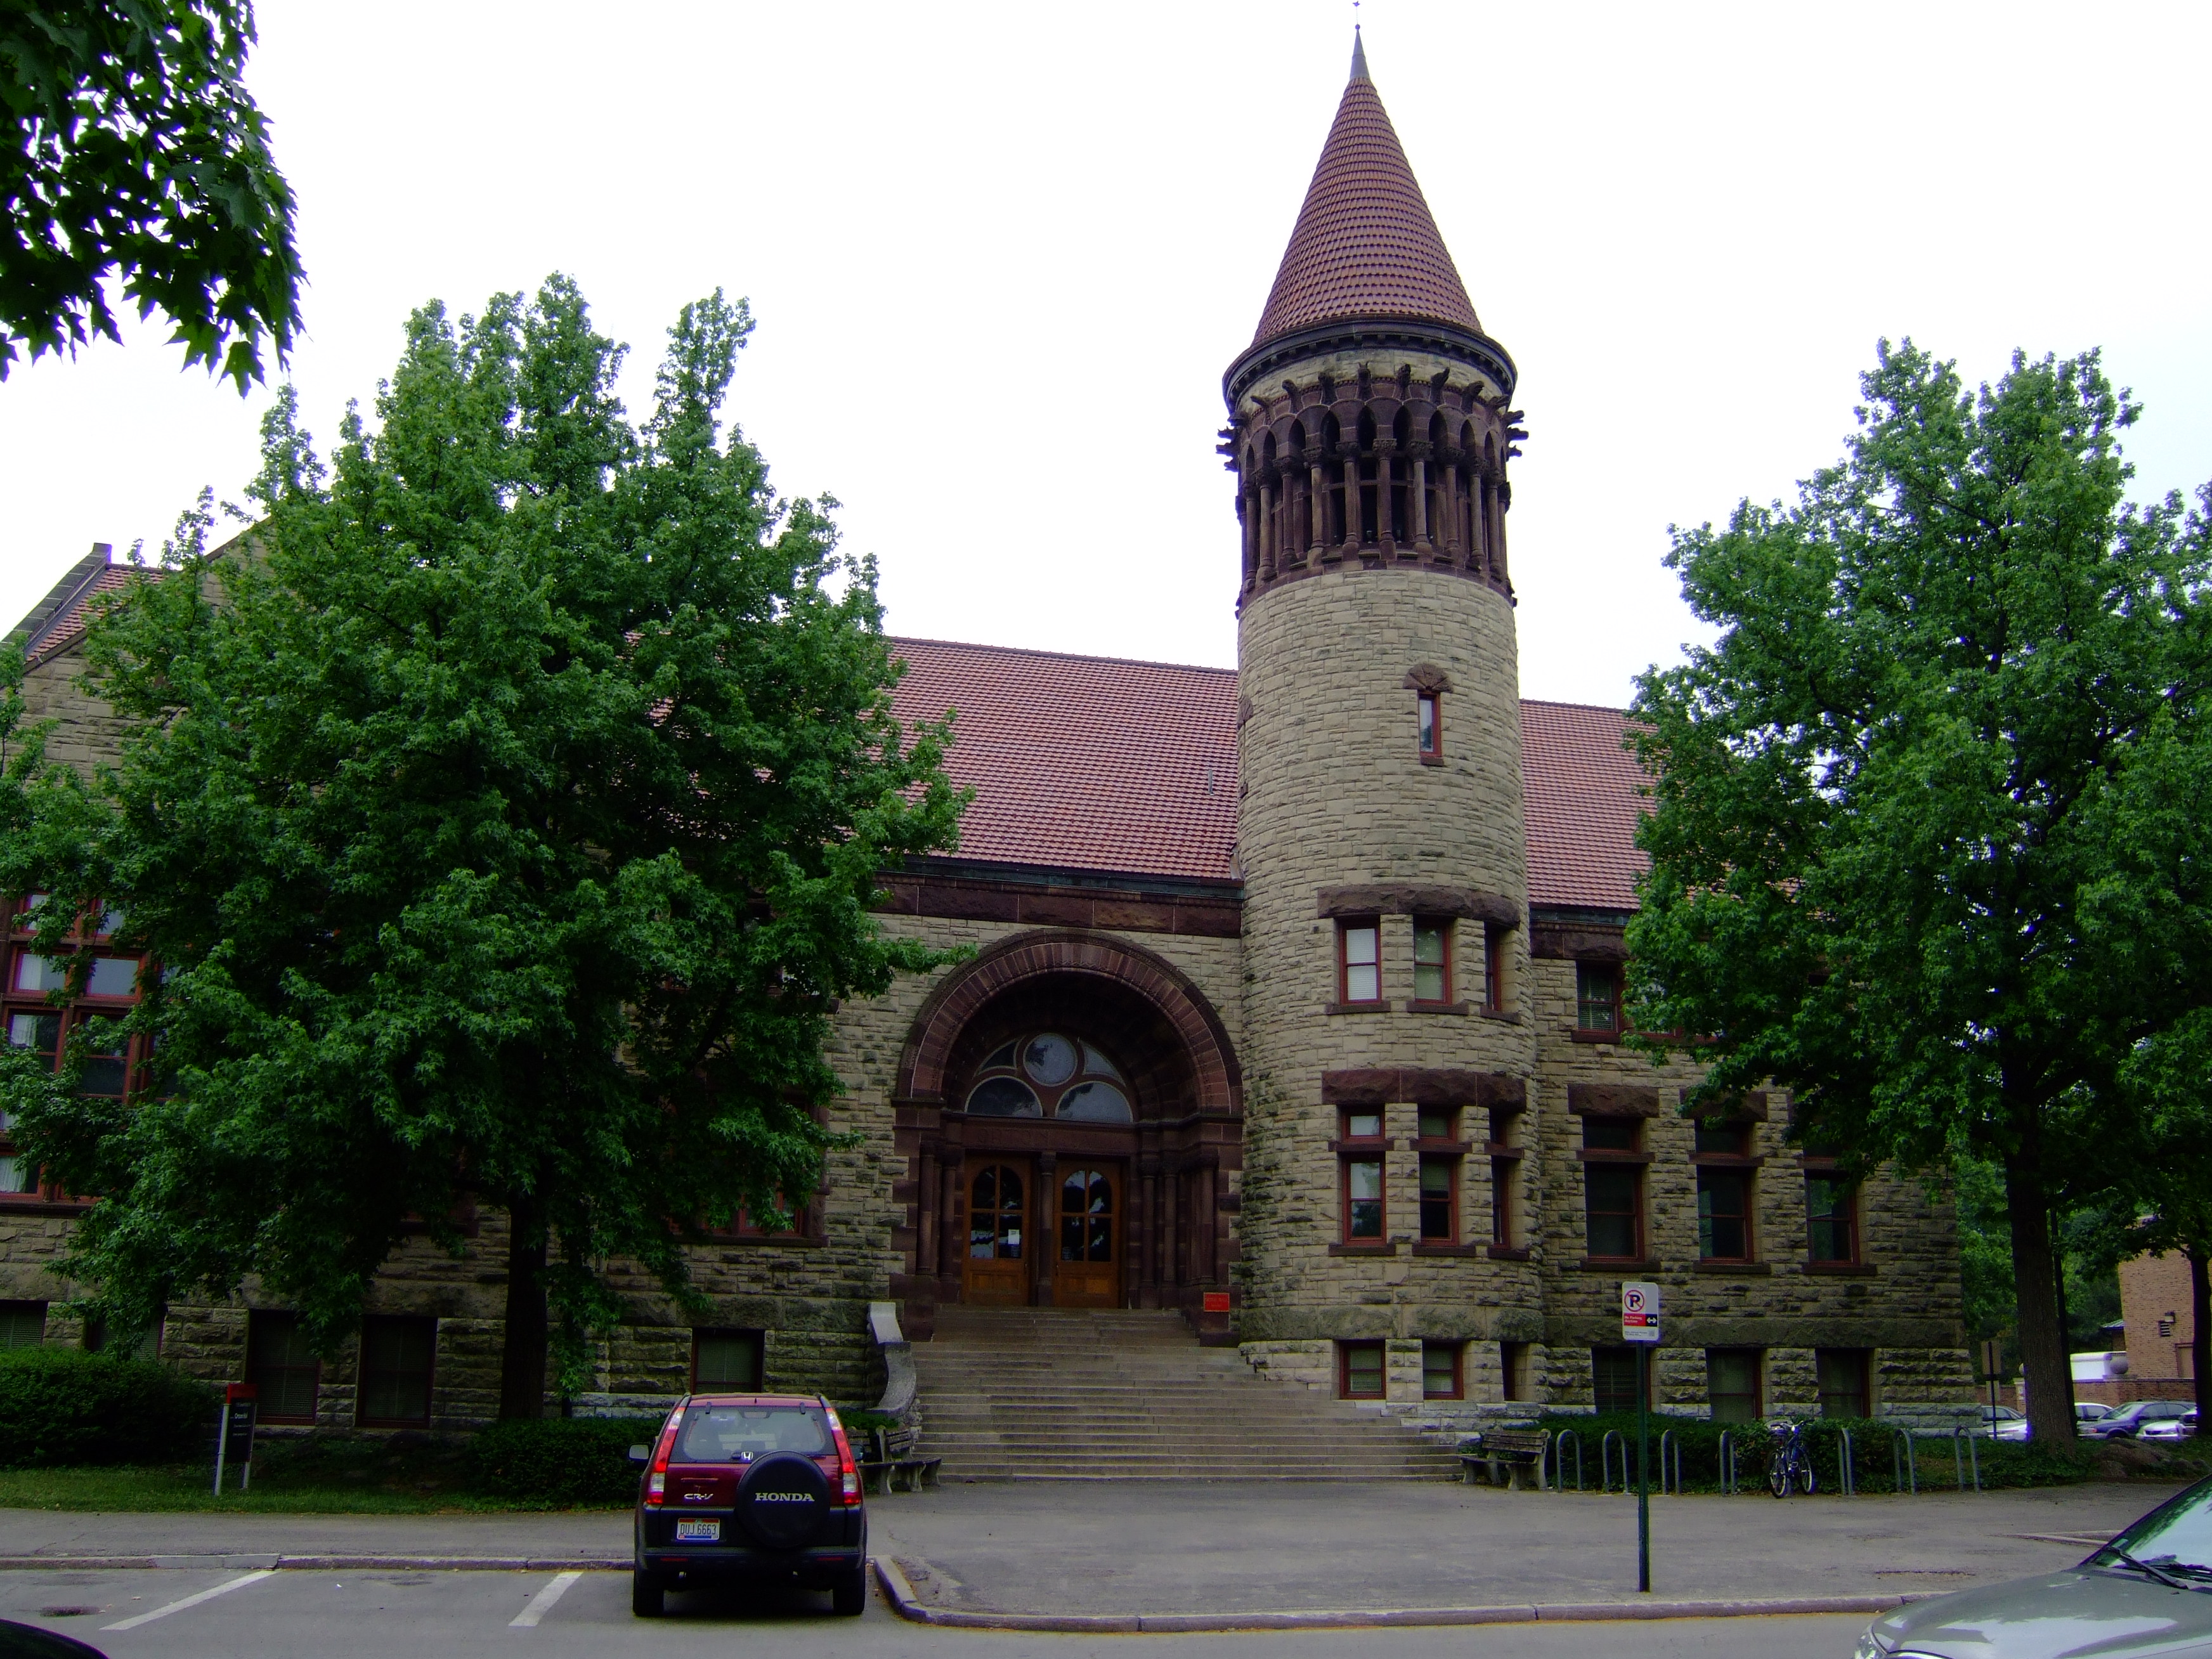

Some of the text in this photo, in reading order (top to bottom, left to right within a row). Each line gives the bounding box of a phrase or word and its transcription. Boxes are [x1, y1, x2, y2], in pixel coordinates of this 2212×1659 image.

[1630, 1294, 1641, 1308] P
[755, 1492, 815, 1502] HONDA
[697, 1524, 717, 1535] 6663
